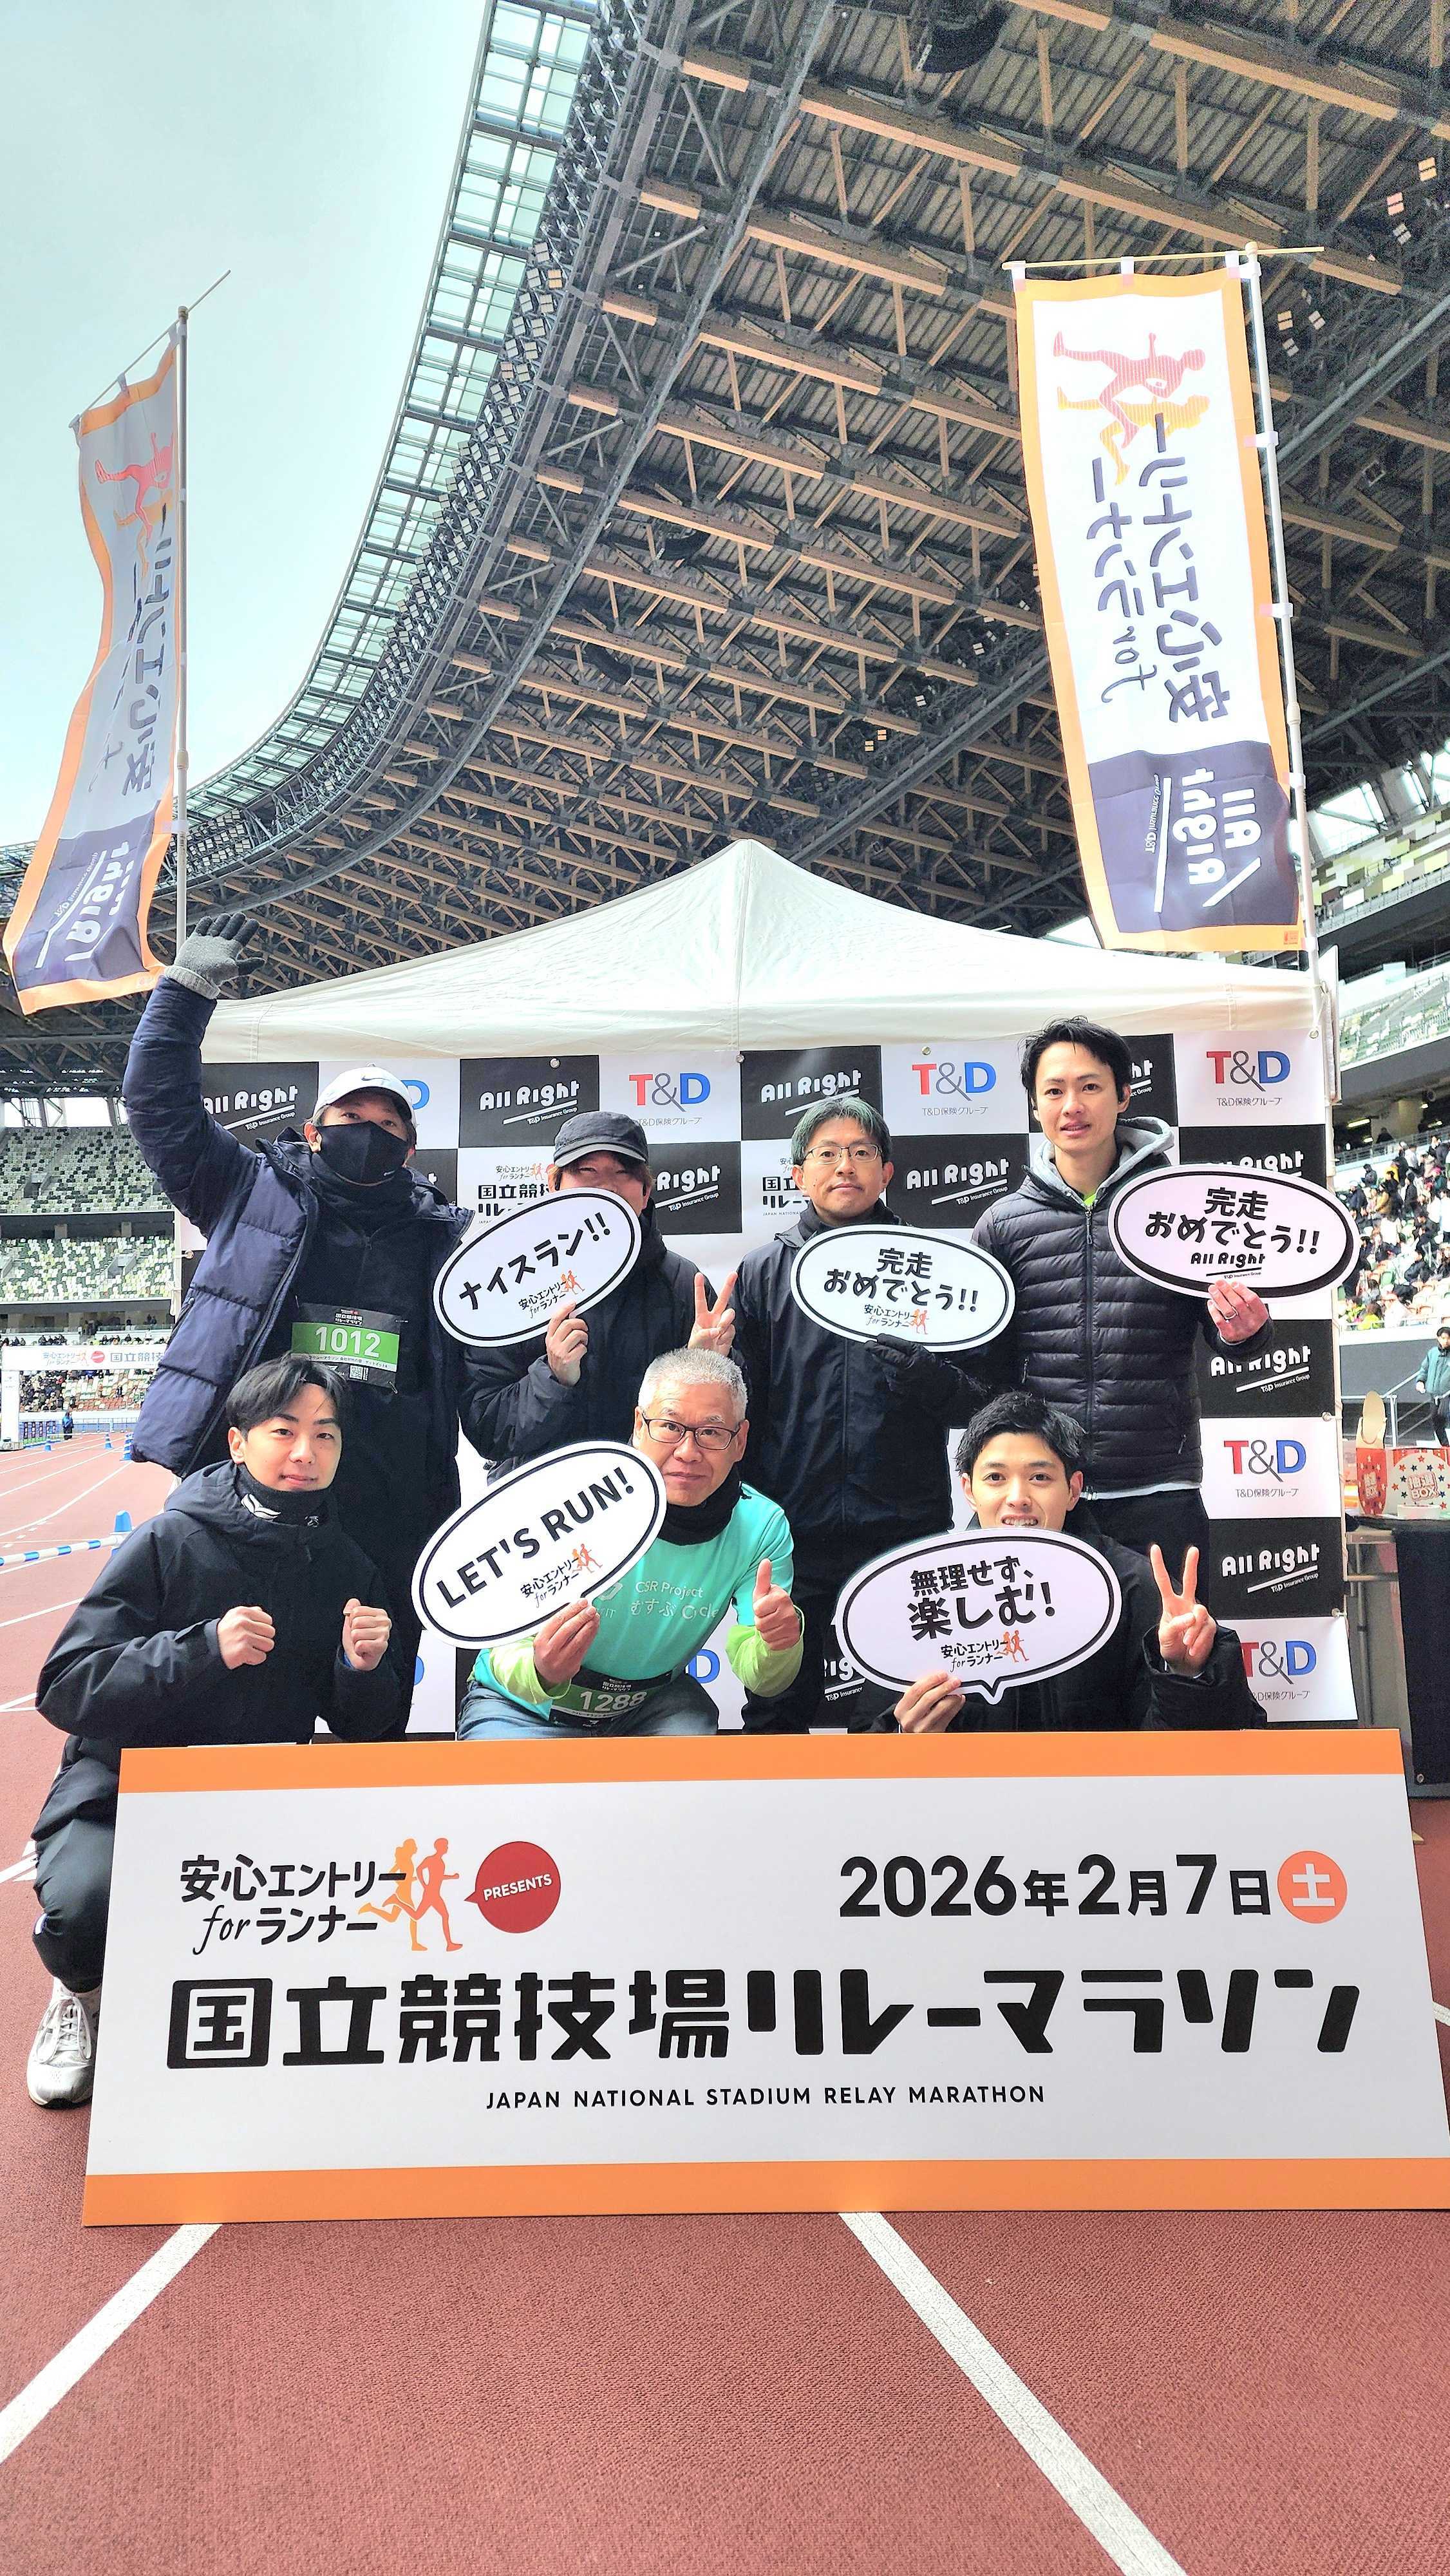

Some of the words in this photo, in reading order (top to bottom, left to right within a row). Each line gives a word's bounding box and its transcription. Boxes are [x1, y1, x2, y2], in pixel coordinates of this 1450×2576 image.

[912, 1062, 997, 1101] T&D
[1206, 1050, 1291, 1092] T&D
[234, 1084, 298, 1112] Right
[480, 1090, 511, 1111] All
[516, 1080, 580, 1106] Right
[628, 1072, 711, 1112] T&D
[761, 1081, 793, 1103] All
[798, 1070, 862, 1096] Right
[1217, 1097, 1283, 1106] T&D保険グループ
[245, 1122, 258, 1131] T&D
[258, 1116, 281, 1126] Insurance
[280, 1111, 296, 1119] Group
[527, 1115, 541, 1124] T&D
[541, 1110, 563, 1121] Insurance
[563, 1106, 578, 1115] Group
[921, 1106, 989, 1116] T&D保険グループ
[657, 1165, 720, 1192] Right
[907, 1169, 938, 1189] All
[945, 1159, 1009, 1186] Right
[668, 1202, 682, 1212] T&D
[681, 1195, 704, 1207] Insurance
[704, 1192, 719, 1201] Group
[956, 1196, 970, 1206] T&D
[970, 1189, 993, 1200] Insurance
[993, 1186, 1008, 1195] Group
[1204, 1187, 1268, 1220] 完走
[1145, 1211, 1320, 1255] おめでとう!!
[459, 1212, 610, 1310] ナイスラン!!
[876, 1248, 933, 1279] 完走
[1191, 1253, 1214, 1264] All
[1218, 1252, 1265, 1268] Right
[518, 1280, 567, 1310] 安心エントリー
[540, 1293, 567, 1310] ランナー
[824, 1269, 978, 1312] おめでとう!!
[863, 1303, 917, 1320] 安心エントリー
[881, 1318, 909, 1328] ランナー
[315, 1327, 381, 1358] 1012
[1260, 1385, 1274, 1394] T&D
[1274, 1378, 1296, 1388] Insurance
[1295, 1373, 1311, 1383] Group
[1223, 1439, 1306, 1482] T&D
[1236, 1488, 1299, 1498] T&D保険グループ
[437, 1528, 540, 1608] LET'S
[541, 1466, 634, 1542] RUN!
[1222, 1554, 1253, 1577] All
[1259, 1544, 1320, 1573] Right
[520, 1557, 579, 1598] 安心エントリー
[547, 1573, 579, 1596] ランナー
[635, 1580, 658, 1593] CSR
[661, 1581, 704, 1600] Project
[910, 1555, 1034, 1597] 無理せず、
[1270, 1584, 1283, 1593] T&D
[1283, 1577, 1305, 1589] Insurance
[1304, 1573, 1319, 1582] Group
[630, 1598, 676, 1618] むすぶ
[907, 1582, 1055, 1641] 楽しむ!
[941, 1639, 1008, 1659] 安心エントリー
[950, 1657, 965, 1672] for
[966, 1654, 1003, 1667] ランナー
[580, 1691, 647, 1712] 1288
[825, 1692, 840, 1702] T&D
[180, 1853, 406, 1903] 安心エントリー
[483, 1872, 552, 1902] PRESENTS
[840, 1853, 1271, 1918] 2026年2月7日
[1292, 1862, 1336, 1908] 土
[193, 1905, 250, 1955] for
[256, 1906, 378, 1945] ランナー
[167, 1969, 1360, 2069] 国立競技場リレーマラソン
[486, 2090, 560, 2110] JAPAN
[574, 2088, 695, 2108] NATIONAL
[706, 2087, 811, 2107] STADIUM
[824, 2086, 897, 2105] RELAY
[909, 2085, 1045, 2105] MARATHON
